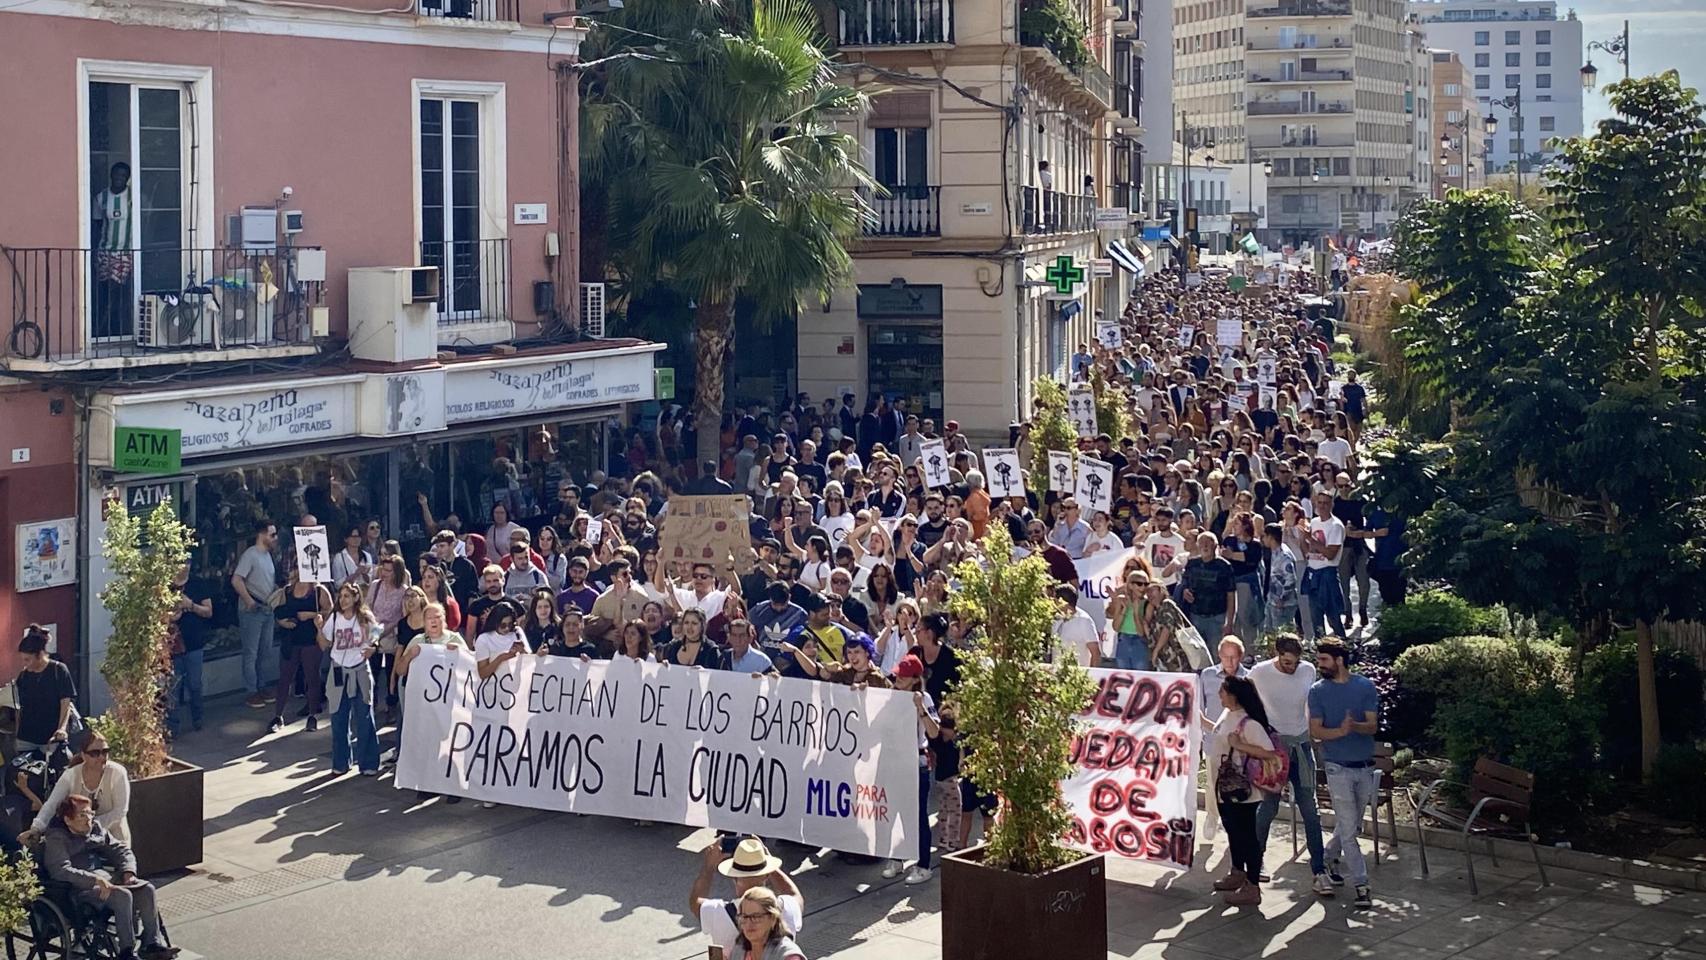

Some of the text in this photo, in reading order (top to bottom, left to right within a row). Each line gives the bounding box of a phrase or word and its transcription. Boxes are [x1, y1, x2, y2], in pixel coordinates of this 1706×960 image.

[475, 398, 515, 411] RELIGIOSOS
[566, 388, 598, 400] COFRADES
[288, 419, 332, 434] COFRADES
[125, 432, 169, 456] ATM
[132, 483, 170, 507] ATM
[462, 670, 516, 711] NOS
[528, 672, 619, 719] ECHAN
[640, 683, 671, 727] DE
[685, 688, 732, 735] LOS
[1083, 671, 1195, 727] EDA
[446, 721, 788, 819] PARAMOS LA CIUDAD
[806, 777, 888, 818] MLG PARA
[851, 804, 890, 823] VIVIR
[1089, 778, 1161, 823] DE
